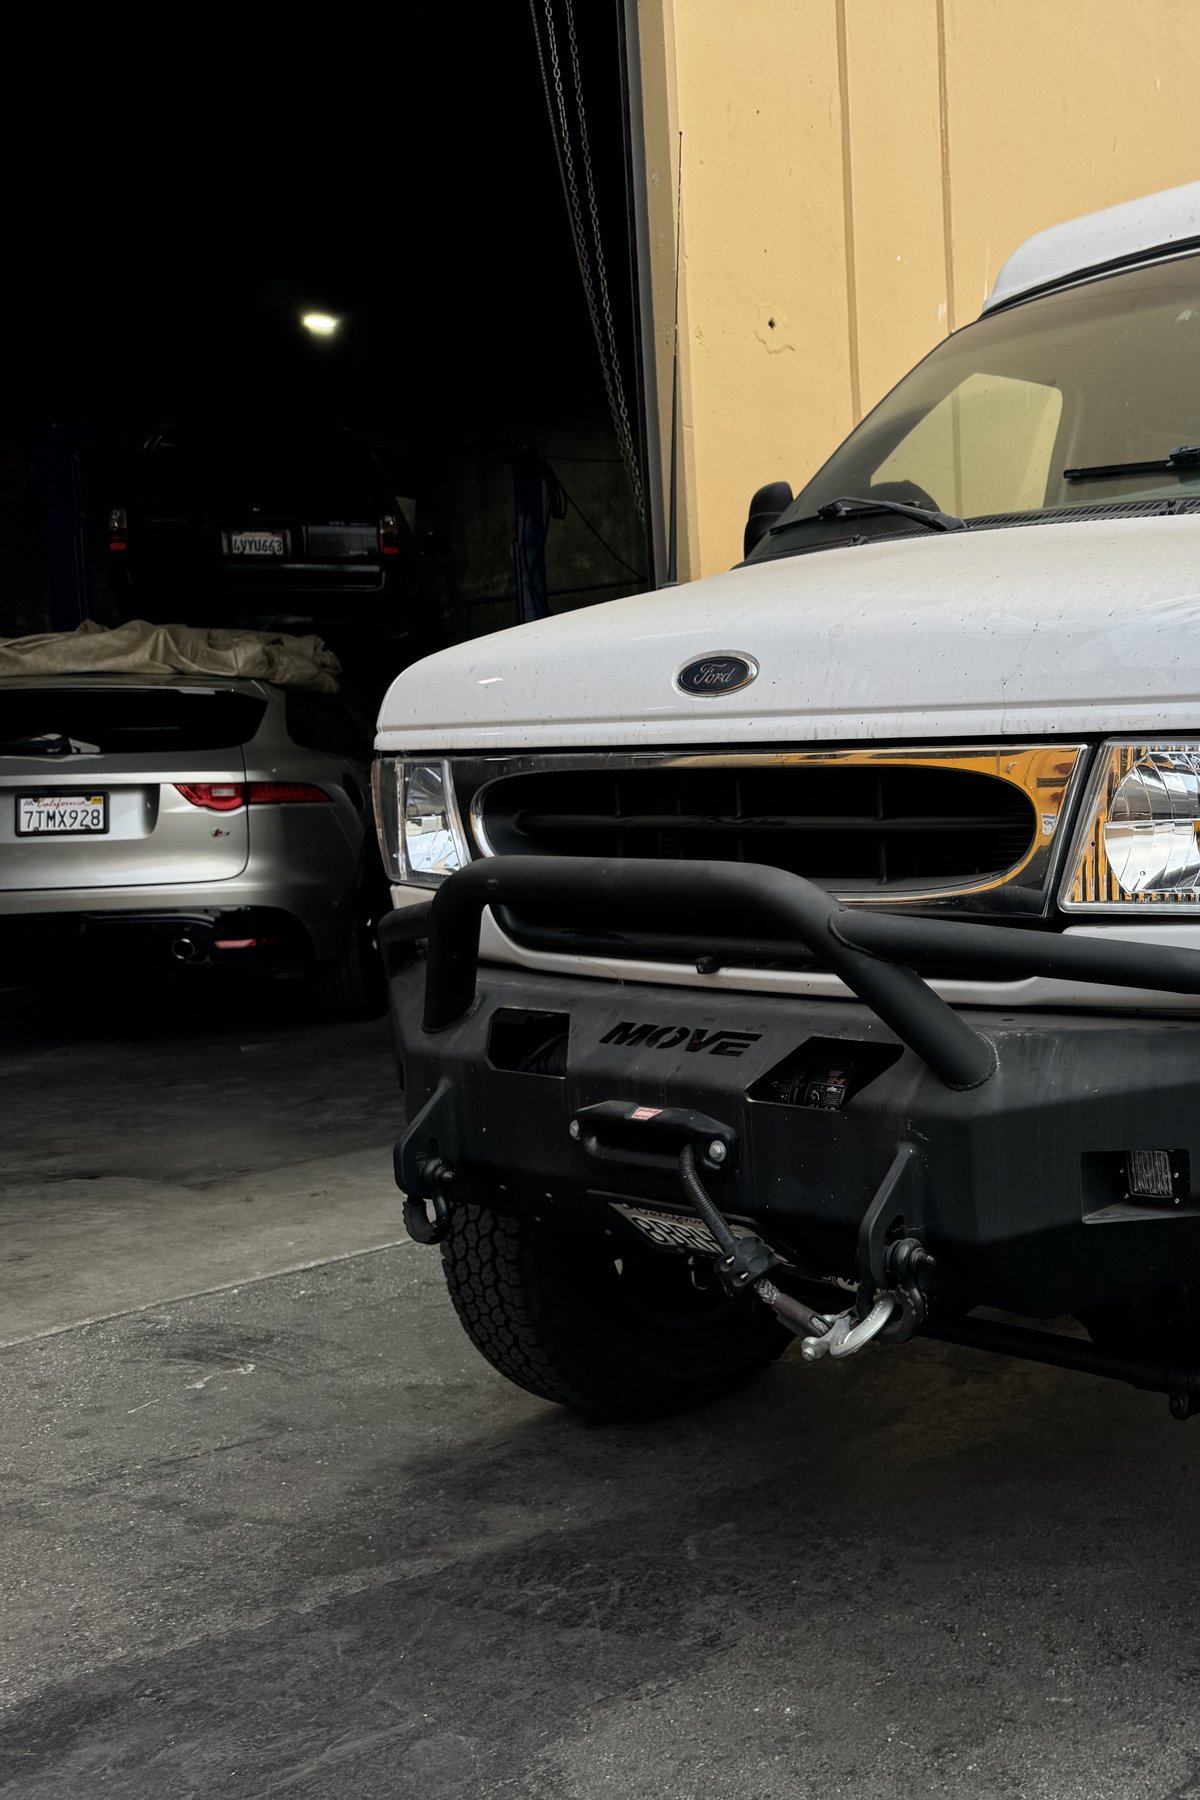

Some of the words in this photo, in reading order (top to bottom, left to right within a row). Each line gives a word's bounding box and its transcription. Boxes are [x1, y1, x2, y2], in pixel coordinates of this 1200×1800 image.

[693, 662, 736, 685] Ford
[37, 797, 90, 809] California
[24, 809, 101, 829] 7TMX928
[599, 1021, 763, 1057] MOVE
